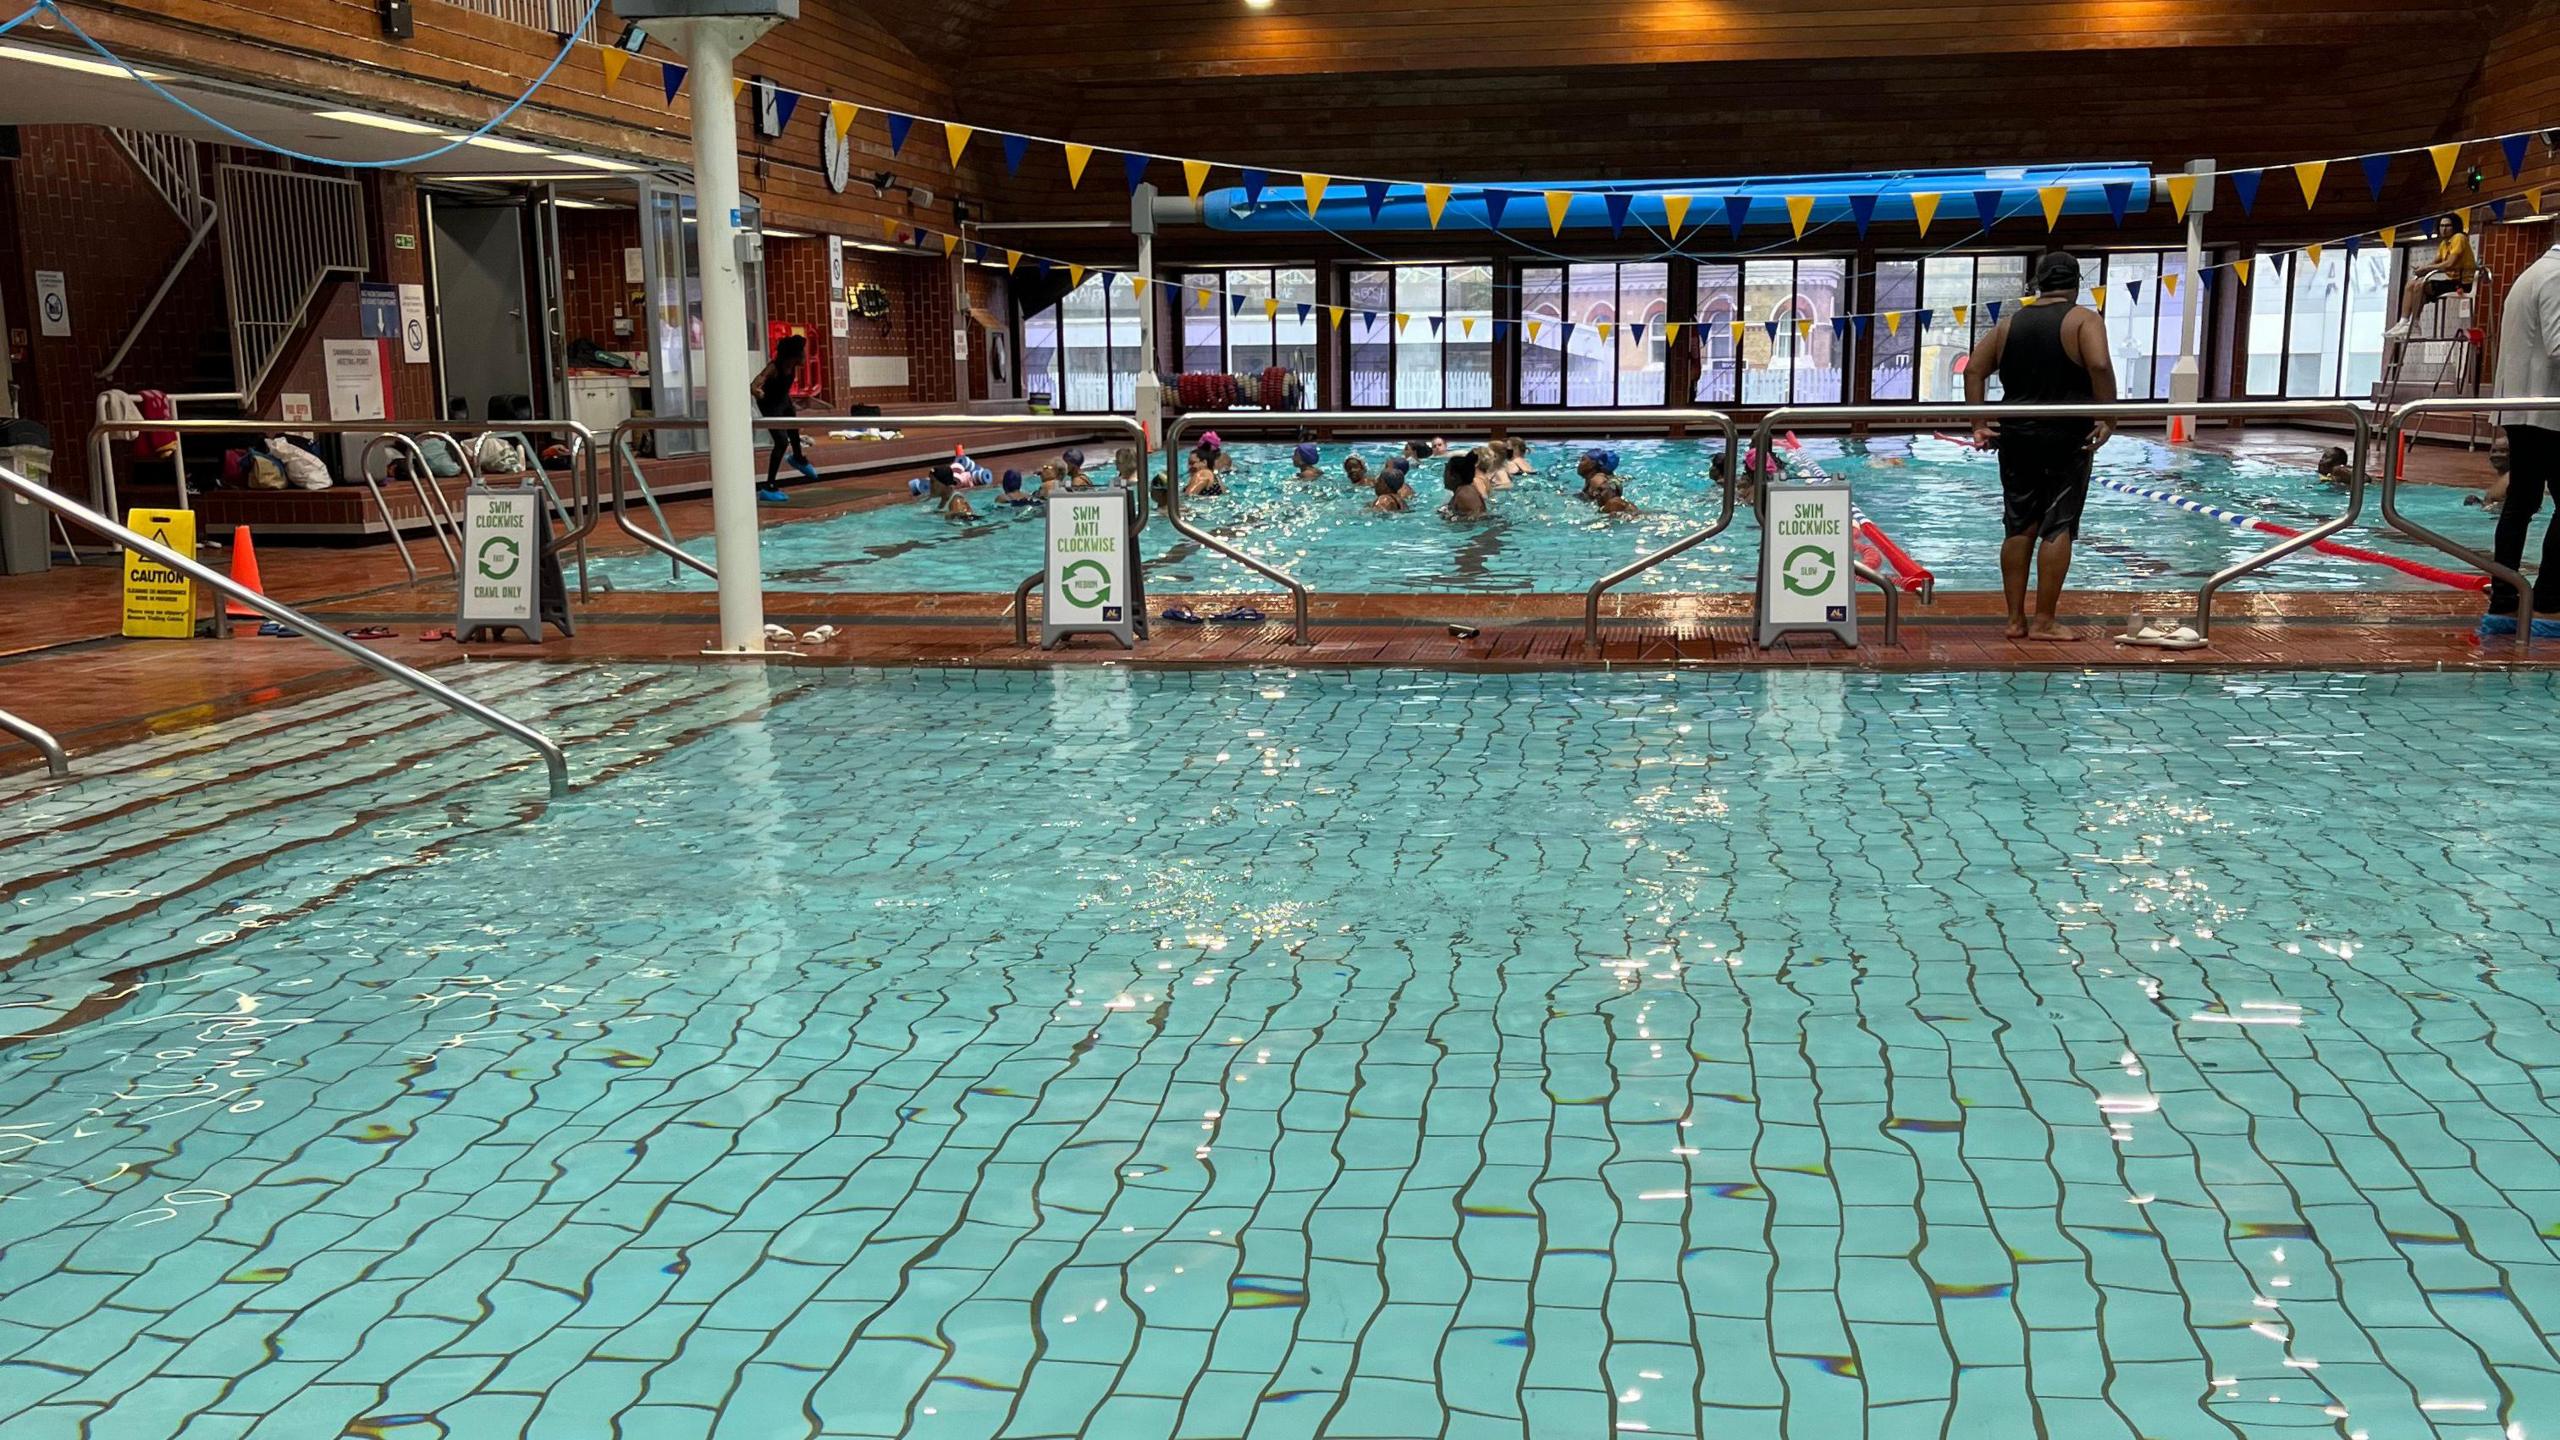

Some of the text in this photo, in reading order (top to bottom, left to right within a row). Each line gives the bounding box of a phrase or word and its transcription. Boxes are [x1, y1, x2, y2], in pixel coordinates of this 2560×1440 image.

[489, 501, 512, 514] SWIM
[1073, 506, 1100, 521] SWIM
[1794, 503, 1824, 519] SWIM
[476, 515, 524, 528] CLOCKWISE
[1778, 520, 1840, 535] CLOCKWISE
[1074, 522, 1099, 536] ANTI
[1057, 537, 1115, 552] CLOCKWISE
[130, 569, 184, 583] CAUTION
[1801, 567, 1818, 576] SLOW
[1075, 580, 1098, 589] MEDIUM
[474, 586, 522, 598] CRAWL ONLY
